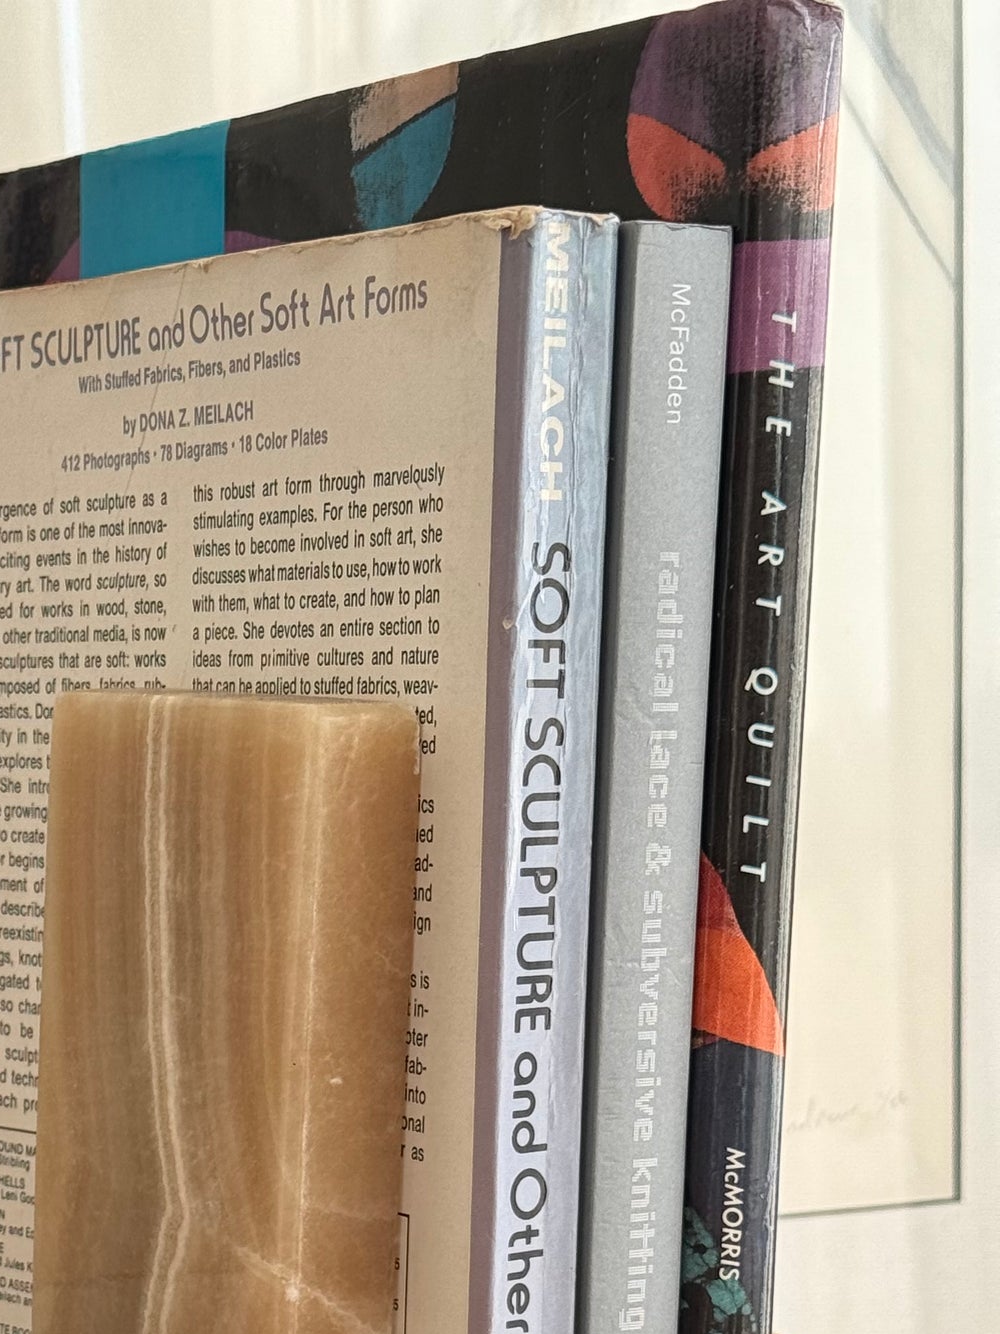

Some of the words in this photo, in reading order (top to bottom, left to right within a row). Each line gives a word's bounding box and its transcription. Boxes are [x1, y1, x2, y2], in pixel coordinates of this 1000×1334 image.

[30, 317, 141, 367] SCULPTURE
[148, 319, 185, 352] and
[189, 305, 255, 344] Other
[260, 289, 310, 333] Soft
[318, 281, 355, 325] Art
[365, 277, 428, 318] Forms
[78, 373, 102, 395] With
[104, 367, 142, 391] Stuffed
[143, 363, 186, 388] Fabrics,
[188, 359, 226, 382] Fibers,
[229, 354, 251, 377] and
[253, 348, 302, 373] Plastics
[539, 221, 572, 502] MEILACH
[666, 283, 692, 426] McFadden
[765, 311, 797, 436] THE
[122, 415, 137, 438] by
[138, 410, 176, 434] DONA
[179, 407, 191, 429] Z.
[193, 401, 254, 428] MEILACH
[61, 455, 80, 473] 412
[83, 447, 151, 471] Photographs
[160, 442, 172, 463] 78
[175, 438, 229, 463] Diagrams
[239, 434, 252, 454] 18
[255, 430, 289, 453] Color
[290, 426, 329, 449] Plates
[43, 497, 54, 515] of
[60, 495, 81, 514] soft
[86, 492, 135, 514] sculpture
[142, 491, 154, 507] as
[160, 491, 167, 506] a
[193, 485, 213, 502] this
[220, 481, 255, 500] robust
[262, 479, 278, 497] art
[285, 477, 312, 495] form
[319, 470, 365, 494] through
[372, 462, 445, 489] marvelously
[27, 526, 36, 542] is
[40, 526, 60, 541] one
[64, 523, 75, 539] of
[78, 522, 95, 538] the
[99, 520, 124, 537] most
[128, 517, 167, 535] innova-
[193, 511, 254, 531] stimulating
[259, 505, 317, 528] examples.
[323, 503, 343, 521] For
[348, 501, 367, 519] the
[372, 499, 413, 521] person
[419, 493, 443, 513] who
[36, 550, 71, 567] events
[77, 549, 87, 565] in
[93, 547, 110, 564] the
[115, 545, 151, 565] history
[157, 542, 167, 559] of
[193, 540, 231, 557] wishes
[235, 539, 245, 556] to
[250, 536, 295, 554] become
[300, 531, 349, 552] involved
[354, 529, 364, 548] in
[370, 527, 392, 547] soft
[397, 526, 416, 548] art,
[421, 524, 443, 543] she
[755, 491, 787, 616] ART
[16, 578, 34, 594] art.
[39, 576, 60, 593] The
[65, 574, 92, 591] word
[96, 572, 149, 593] sculpture,
[154, 572, 166, 587] so
[192, 567, 245, 585] discusses
[249, 564, 275, 583] what
[277, 561, 330, 580] materials
[332, 562, 343, 579] to
[346, 562, 370, 580] use,
[372, 558, 397, 577] how
[398, 557, 409, 575] to
[413, 554, 441, 574] work
[526, 541, 570, 700] SOFT
[652, 551, 684, 713] radical
[192, 650, 221, 667] ideas
[228, 649, 253, 667] from
[261, 648, 309, 671] primitive
[317, 647, 364, 666] cultures
[372, 646, 393, 665] and
[401, 646, 439, 665] nature
[17, 729, 27, 744] in
[33, 729, 50, 745] the
[646, 729, 678, 828] lace
[740, 666, 778, 883] QUILT
[4, 802, 48, 823] growing
[11, 829, 45, 843] create
[9, 852, 45, 872] begins
[513, 717, 565, 1034] SCULPTURE
[645, 843, 672, 876] &
[34, 878, 44, 893] of
[632, 890, 667, 1142] subversive
[511, 1051, 548, 1155] and
[719, 1147, 746, 1281] McMORRIS
[505, 1167, 548, 1334] Other
[618, 1158, 658, 1331] knitting
